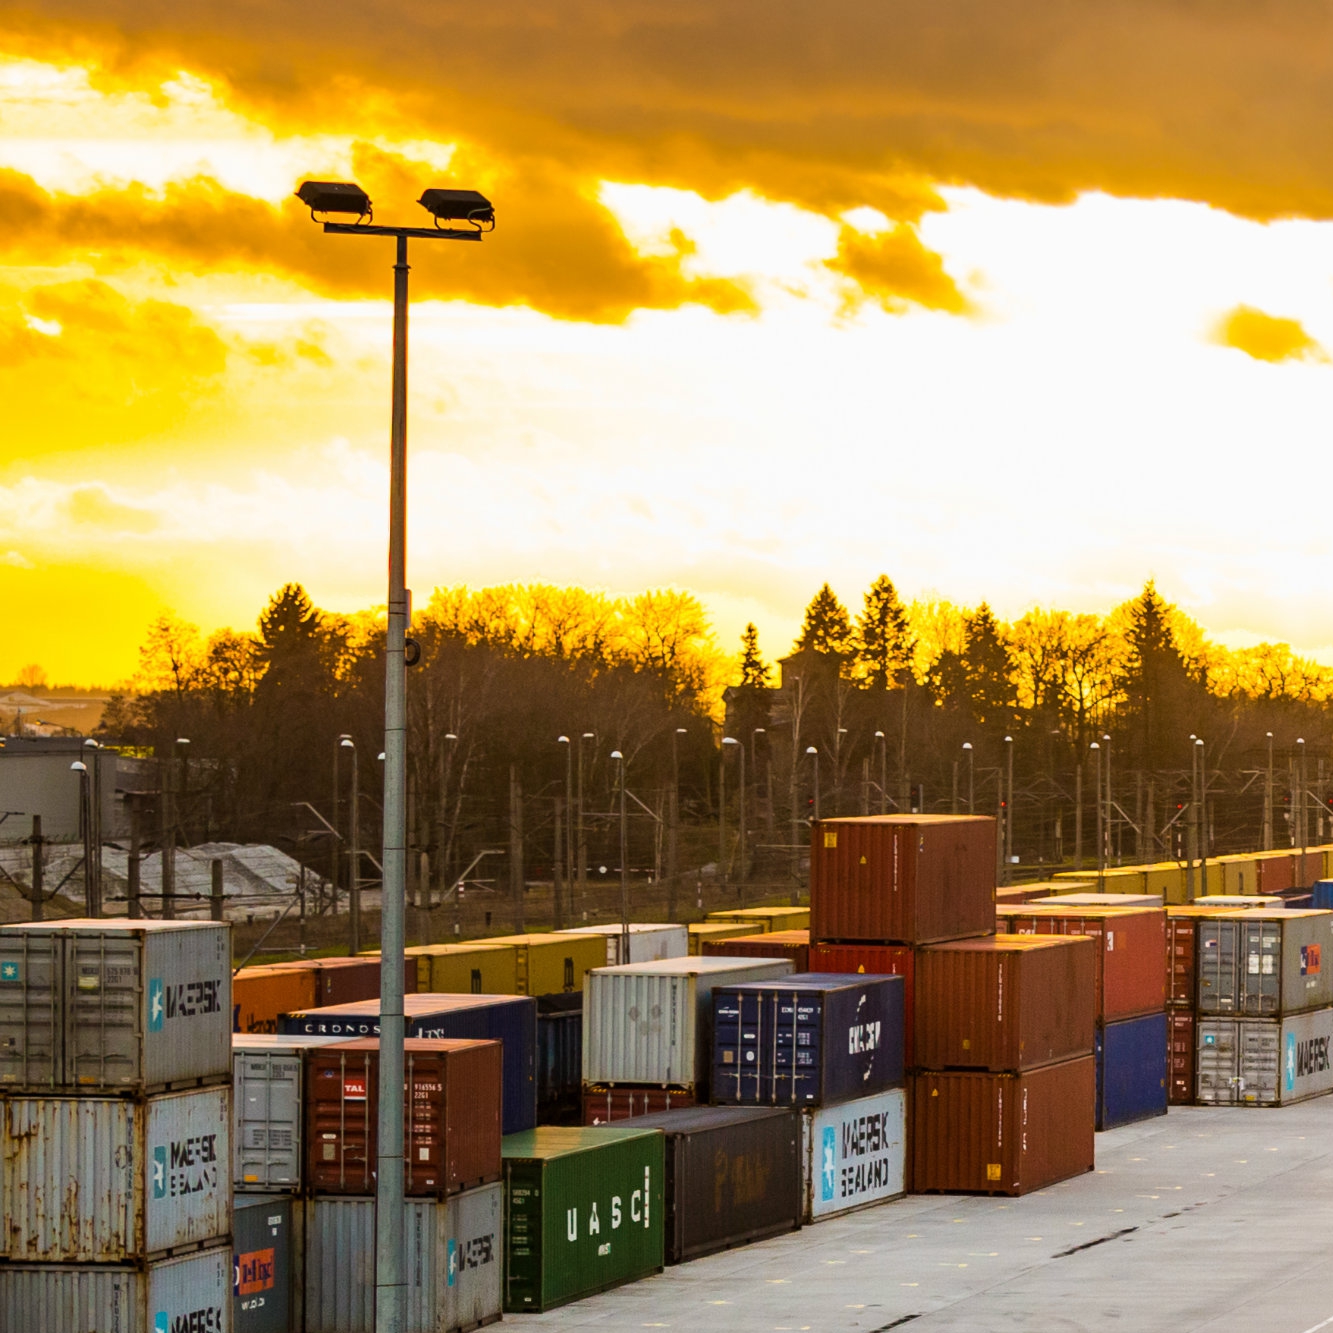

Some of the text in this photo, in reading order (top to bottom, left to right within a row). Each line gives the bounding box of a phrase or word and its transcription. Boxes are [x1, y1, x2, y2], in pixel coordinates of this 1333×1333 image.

[305, 1024, 381, 1034] CRONOS
[344, 1085, 365, 1093] TAL
[842, 1111, 890, 1160] MAERSK
[841, 1157, 889, 1198] SEALAND
